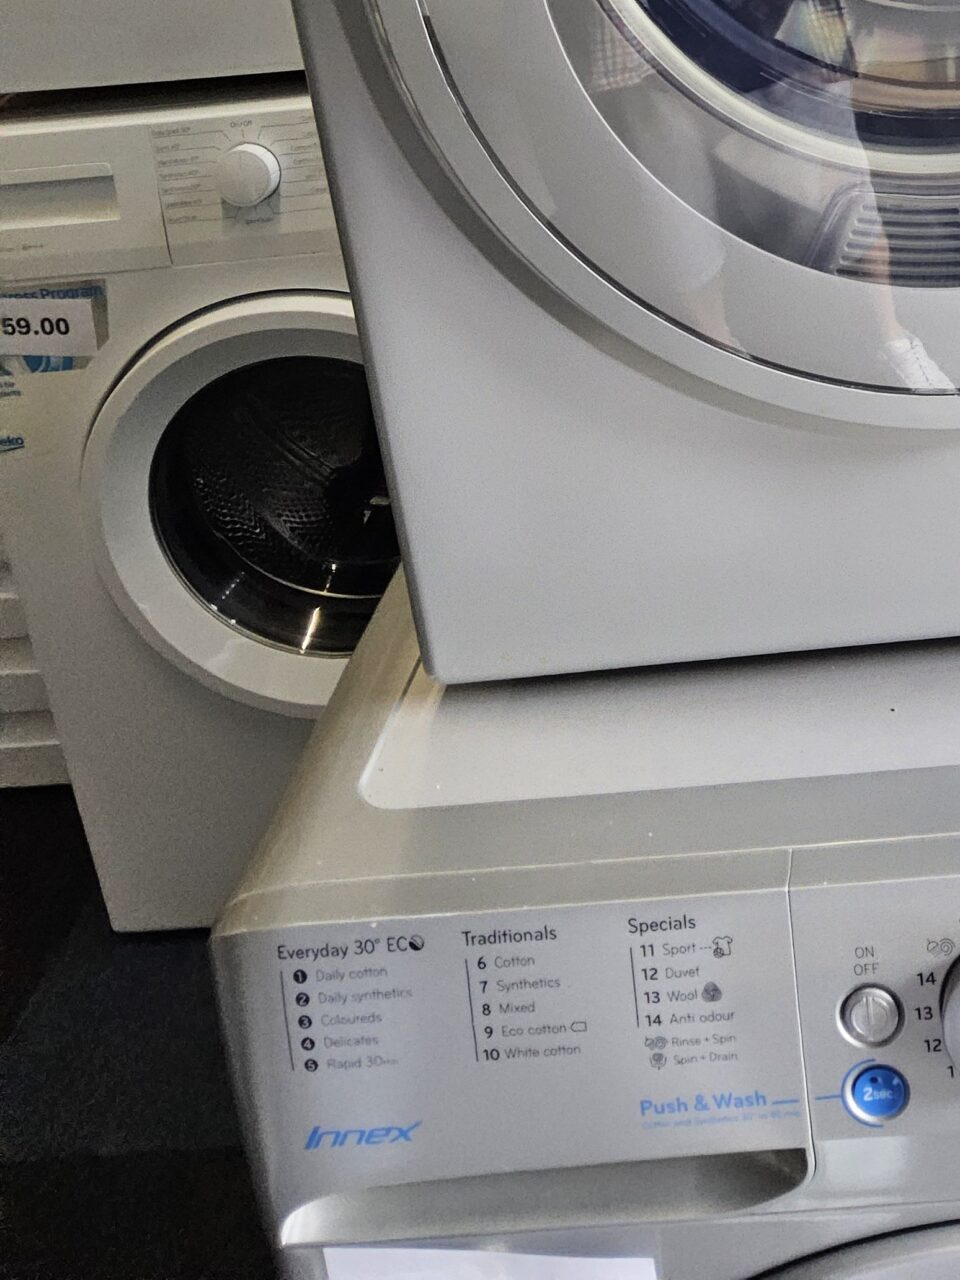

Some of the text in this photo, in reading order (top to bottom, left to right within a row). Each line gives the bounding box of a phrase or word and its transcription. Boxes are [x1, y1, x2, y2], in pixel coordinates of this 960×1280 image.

[628, 914, 696, 937] Specials
[461, 925, 558, 948] Traditionals
[277, 943, 349, 961] Everyday
[640, 943, 696, 958] 11 Sport
[854, 946, 875, 960] ON
[477, 954, 536, 970] 6 Cotton
[853, 962, 879, 977] OFF
[315, 968, 347, 984] Daily
[349, 966, 388, 980] cotton
[641, 967, 700, 981] 12 Duvet
[917, 972, 937, 986] 14
[479, 976, 562, 994] 7 Synthetics
[317, 991, 348, 1006] Daily
[351, 988, 413, 1004] synthetics
[643, 989, 698, 1004] 13 Wool
[482, 1001, 536, 1017] 8 Mixed
[914, 1006, 933, 1020] 13
[320, 1012, 382, 1026] Coloureds
[645, 1010, 736, 1027] 14 Anti odour
[484, 1021, 567, 1039] 9 Eco cotton
[323, 1035, 379, 1049] Delicates
[671, 1033, 736, 1048] Rinse Spin
[924, 1039, 942, 1052] 12
[482, 1044, 582, 1062] 10 White cotton
[673, 1051, 738, 1066] Spin Drain
[326, 1057, 362, 1071] Rapid
[639, 1089, 767, 1117] Push & Wash
[304, 1120, 423, 1150] Innex
